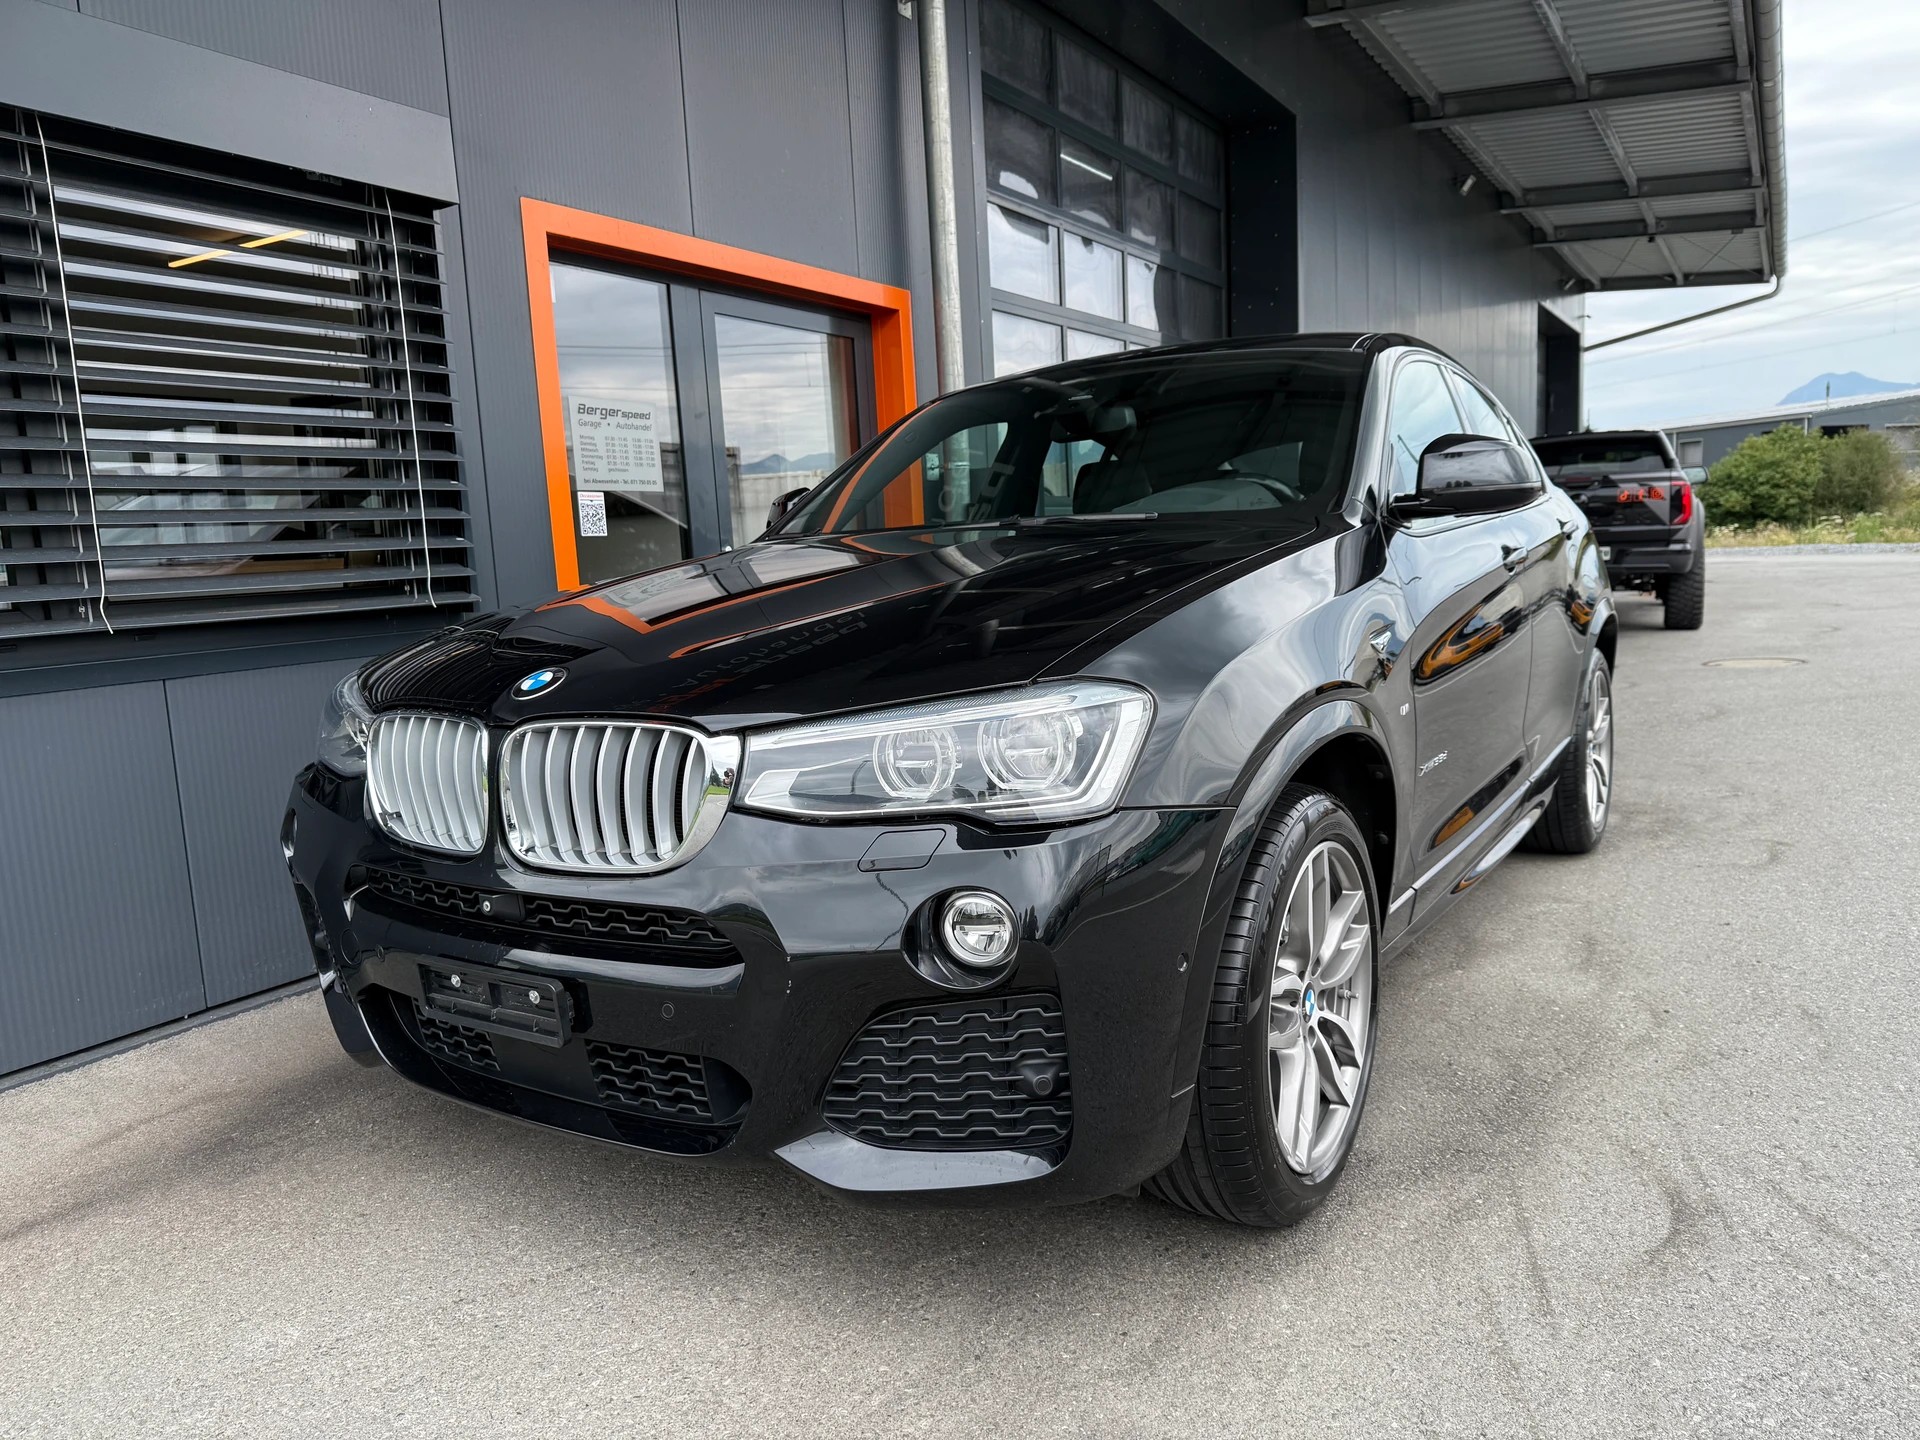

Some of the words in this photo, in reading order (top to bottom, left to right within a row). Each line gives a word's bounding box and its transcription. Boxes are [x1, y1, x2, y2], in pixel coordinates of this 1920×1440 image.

[577, 403, 651, 420] Bergerspeed
[578, 419, 602, 429] Garage
[616, 422, 652, 431] Autohandel
